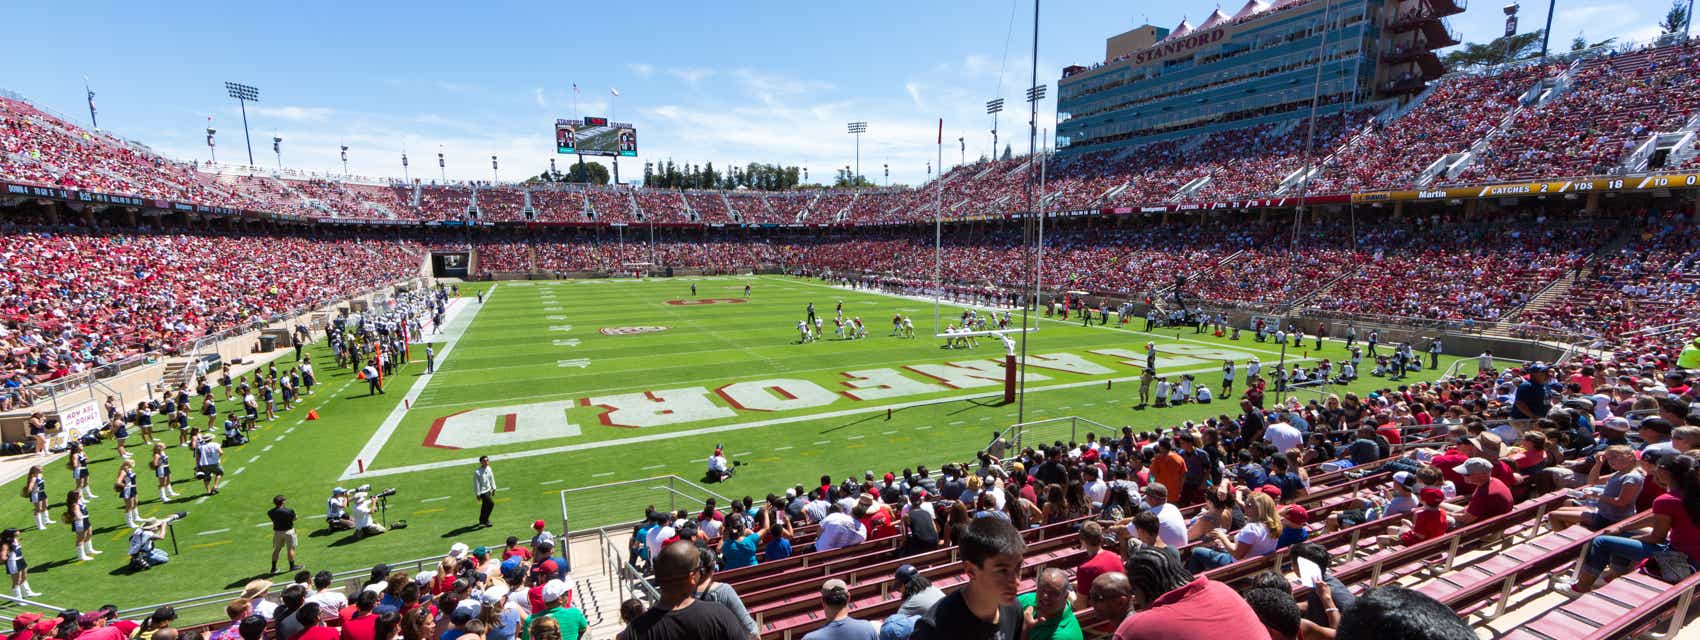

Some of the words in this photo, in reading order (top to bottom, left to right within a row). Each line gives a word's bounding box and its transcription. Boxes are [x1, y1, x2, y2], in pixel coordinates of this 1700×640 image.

[1136, 29, 1225, 64] STANFORD
[1418, 190, 1446, 199] Martin
[1491, 185, 1530, 194] CATCHES
[1540, 184, 1548, 192] 2
[1574, 182, 1593, 190] YDS
[1608, 179, 1624, 189] 18
[1654, 177, 1668, 186] TD
[1686, 175, 1696, 185] 0
